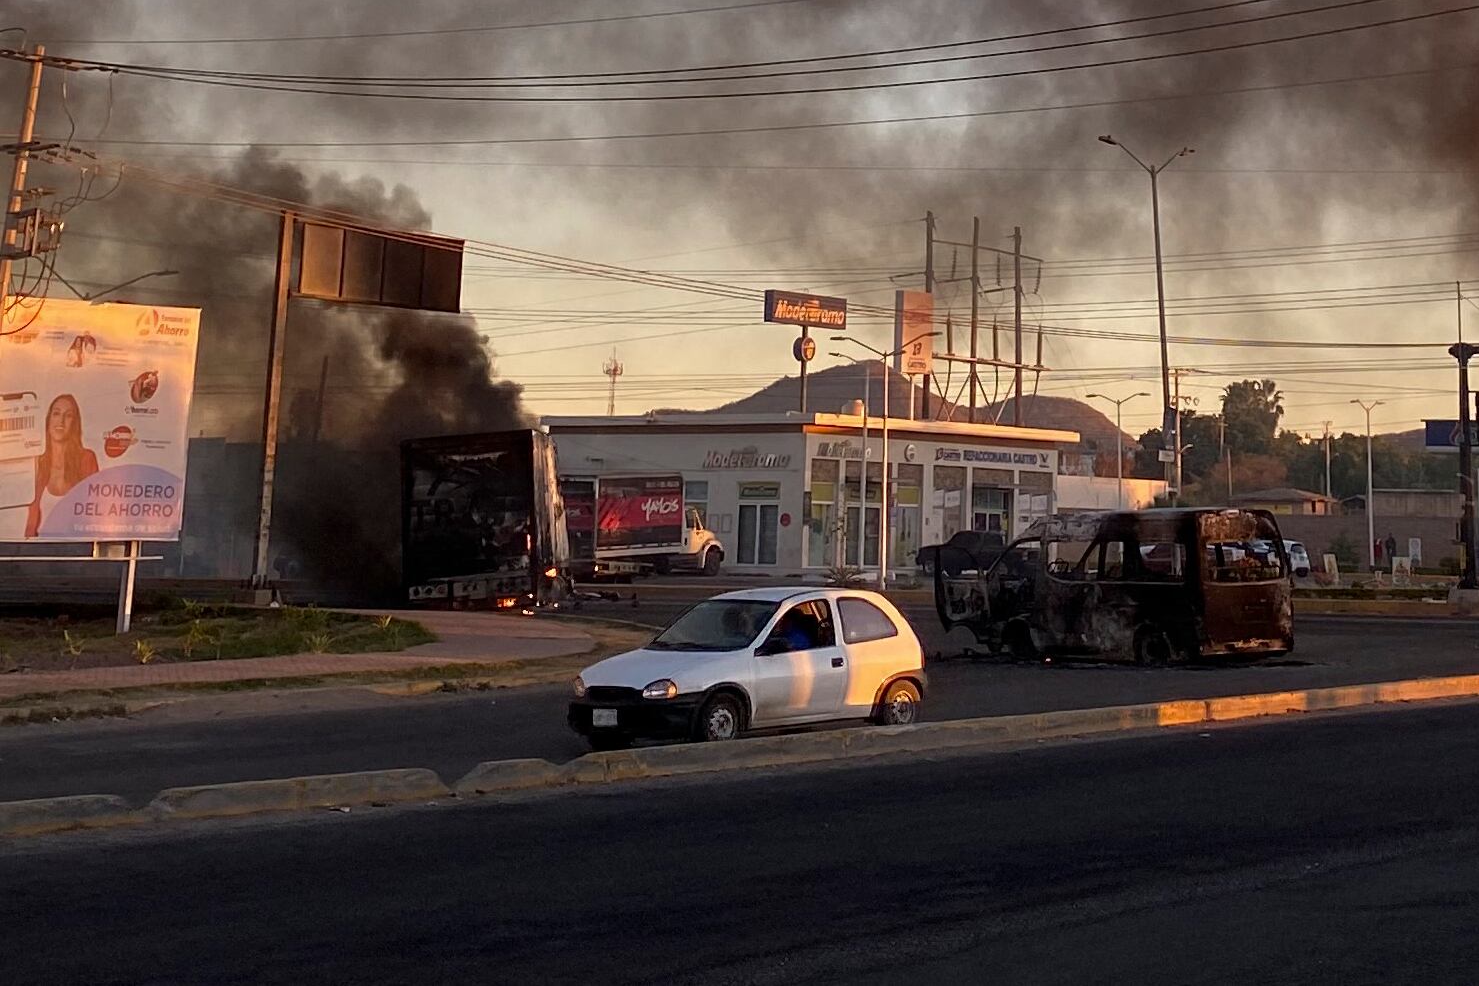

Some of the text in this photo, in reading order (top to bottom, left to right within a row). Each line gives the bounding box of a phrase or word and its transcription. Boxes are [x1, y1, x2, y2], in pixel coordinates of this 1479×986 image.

[87, 483, 175, 499] MONEDERO
[74, 502, 174, 518] DEL AHORRO
